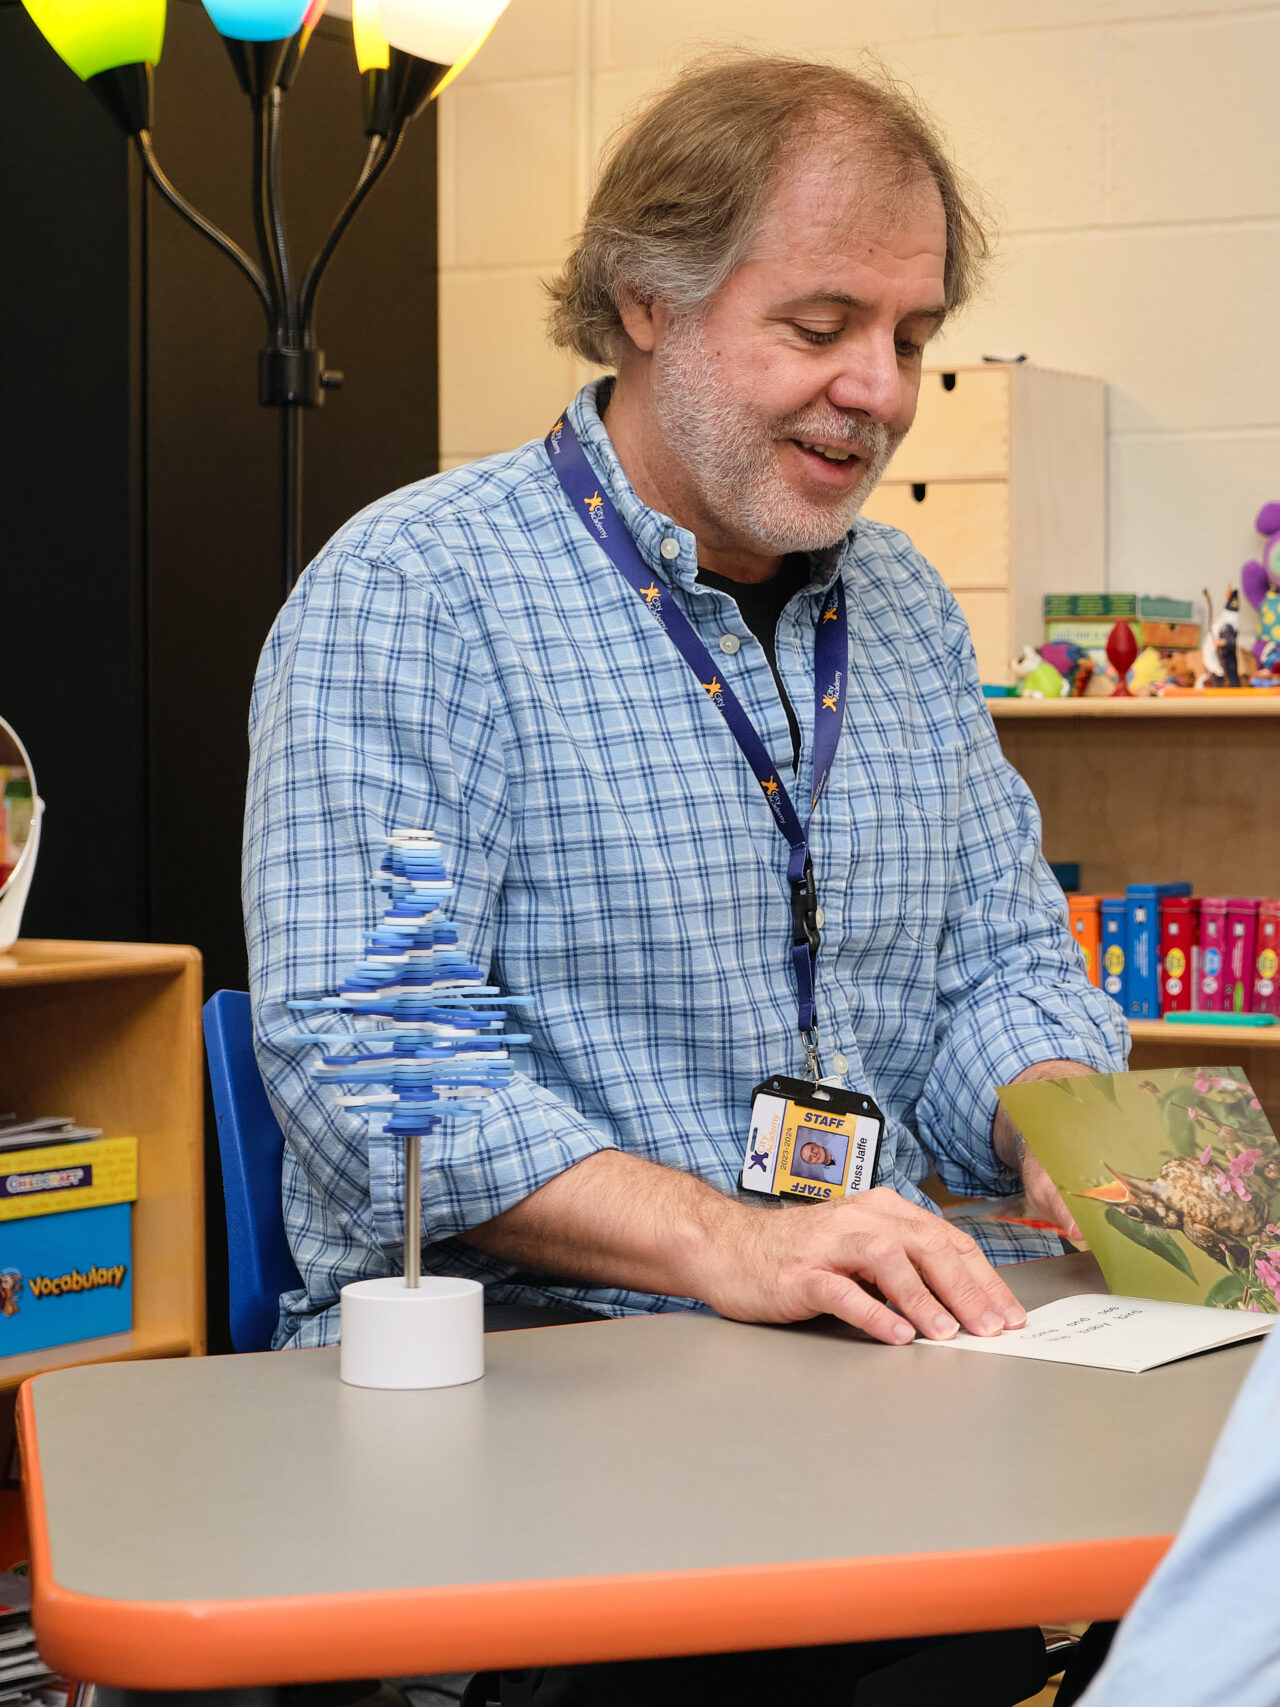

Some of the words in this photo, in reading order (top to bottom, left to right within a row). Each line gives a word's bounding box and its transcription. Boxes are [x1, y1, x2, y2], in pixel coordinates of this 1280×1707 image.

[594, 505, 605, 520] City
[588, 511, 608, 539] Academy
[651, 596, 663, 612] City
[826, 685, 835, 699] City
[833, 670, 842, 699] Academy
[713, 692, 725, 708] City
[767, 794, 787, 824] Academy
[772, 790, 782, 806] City
[804, 1112, 845, 1129] STAFF
[757, 1134, 769, 1153] City
[767, 1114, 780, 1154] Academy
[780, 1127, 793, 1171] 2023-2024
[856, 1137, 868, 1163] Jaffe
[850, 1163, 864, 1191] Russ
[790, 1182, 832, 1199] STAFF
[28, 1264, 126, 1298] Vocabulary
